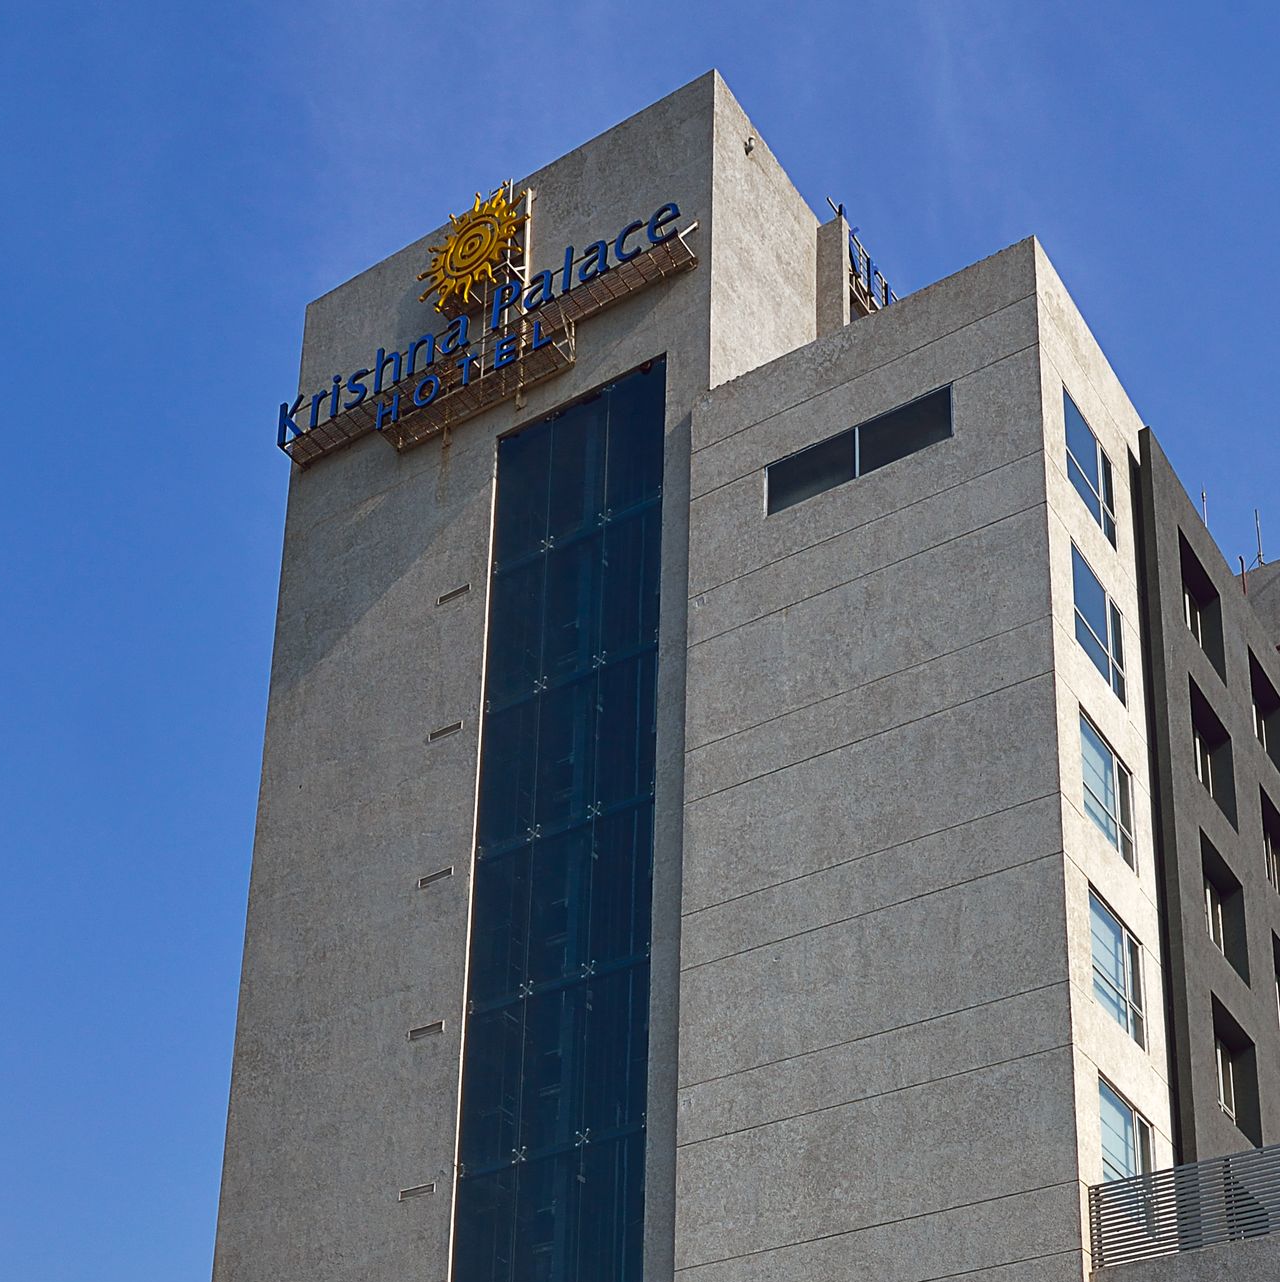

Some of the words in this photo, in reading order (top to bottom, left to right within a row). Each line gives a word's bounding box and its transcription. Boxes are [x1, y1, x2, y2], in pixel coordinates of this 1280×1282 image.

[277, 314, 469, 448] Krishna
[491, 202, 681, 331] Palace
[375, 320, 554, 431] HOTEL
